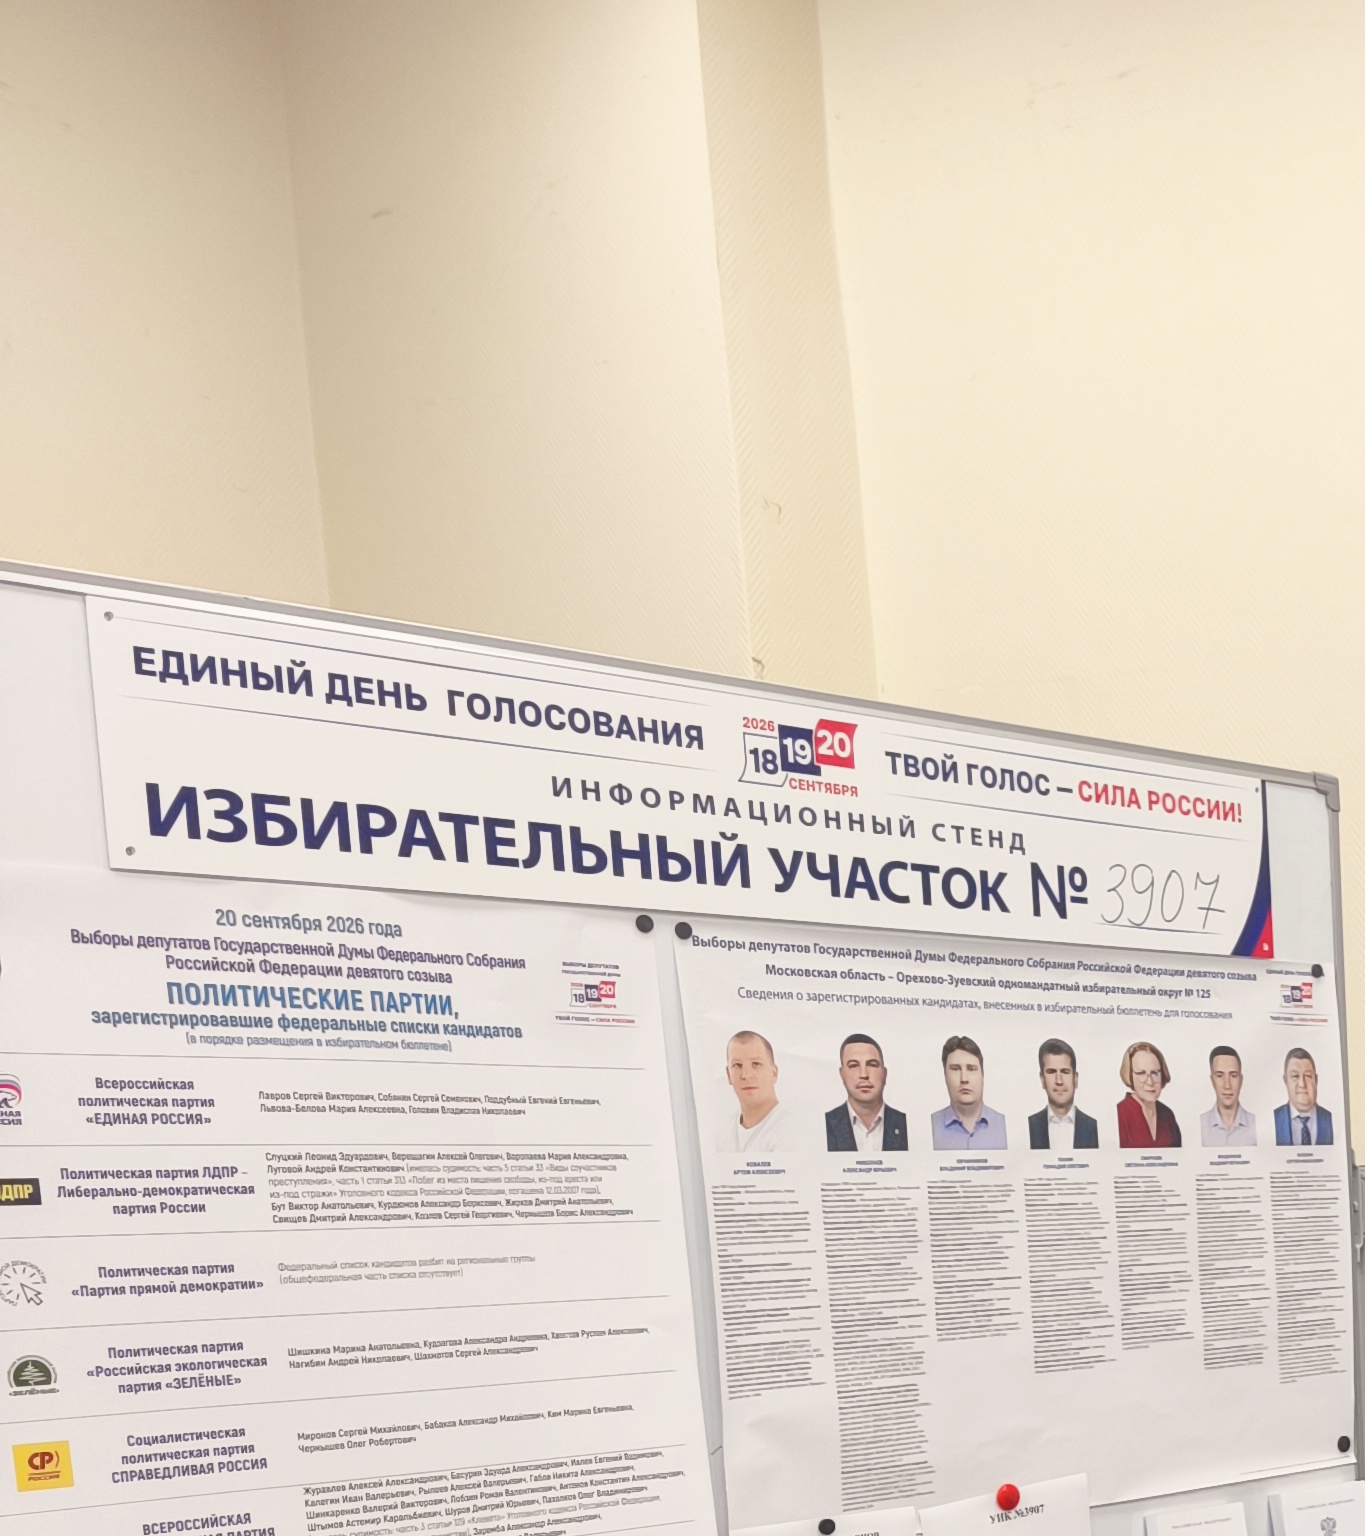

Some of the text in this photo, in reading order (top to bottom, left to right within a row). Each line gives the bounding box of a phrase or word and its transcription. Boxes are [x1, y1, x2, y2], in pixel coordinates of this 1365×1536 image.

[133, 646, 703, 750] ЕДИНЫЙ ДЕНЬ ГОЛОСОВАНИЯ
[742, 716, 776, 732] 2026
[749, 728, 852, 775] 18 19 20
[788, 776, 859, 798] СЕНТЯБРЯ
[885, 751, 1242, 823] ТВОЙ ГОЛОС СИЛА РОССИИ!
[551, 775, 1027, 855] ИНФОРМАЦИОННЫЙ СТЕНД
[145, 782, 1089, 920] ИЗБИРАТЕЛЬНЫЙ УЧАСТОК №
[1101, 860, 1227, 930] 3907
[215, 909, 402, 938] 20 сентября 2026 года
[71, 929, 525, 970] Выборы депутатов Государственной Думы Федерального Собрания
[693, 935, 745, 951] Выборы
[749, 942, 810, 954] депутатов
[814, 943, 912, 960] Государственной
[914, 950, 945, 963] Думы
[948, 949, 1025, 967] Федерального
[1026, 955, 1075, 971] Собрания
[1077, 960, 1131, 973] Российской
[1134, 964, 1185, 977] Федерации
[166, 955, 452, 983] Российской Федерации девятого созыва
[766, 964, 1211, 999] Московская область Орехово-Зуевский одномандатный избирательный округ № 125
[167, 982, 458, 1019] ПОЛИТИЧЕСКИЕ ПАРТИИ,
[572, 984, 614, 1004] 18 19 20
[91, 1011, 522, 1038] зарегистрировавшие федеральные списки кандидатов
[95, 1077, 194, 1091] Всероссийская
[78, 1098, 215, 1109] политическая партия
[86, 1113, 211, 1126] «ЕДИНАЯ РОССИЯ»
[60, 1166, 238, 1181] Политическая партия ЛДПР
[57, 1186, 255, 1200] Либерально-демократическая
[113, 1202, 206, 1216] партия России
[98, 1264, 234, 1278] Политическая партия
[72, 1281, 263, 1298] «Партия прямой демократии»
[108, 1342, 243, 1358] Политическая партия
[87, 1358, 267, 1377] «Российская экологическая
[118, 1374, 241, 1394] партия «ЗЕЛЁНЫЕ»
[127, 1428, 245, 1446] Социалистическая
[122, 1445, 255, 1464] политическая партия
[112, 1458, 267, 1483] СПРАВЕДЛИВАЯ РОССИЯ
[143, 1513, 251, 1535] ВСЕРОССИЙСКАЯ
[990, 1512, 1013, 1525] УИК
